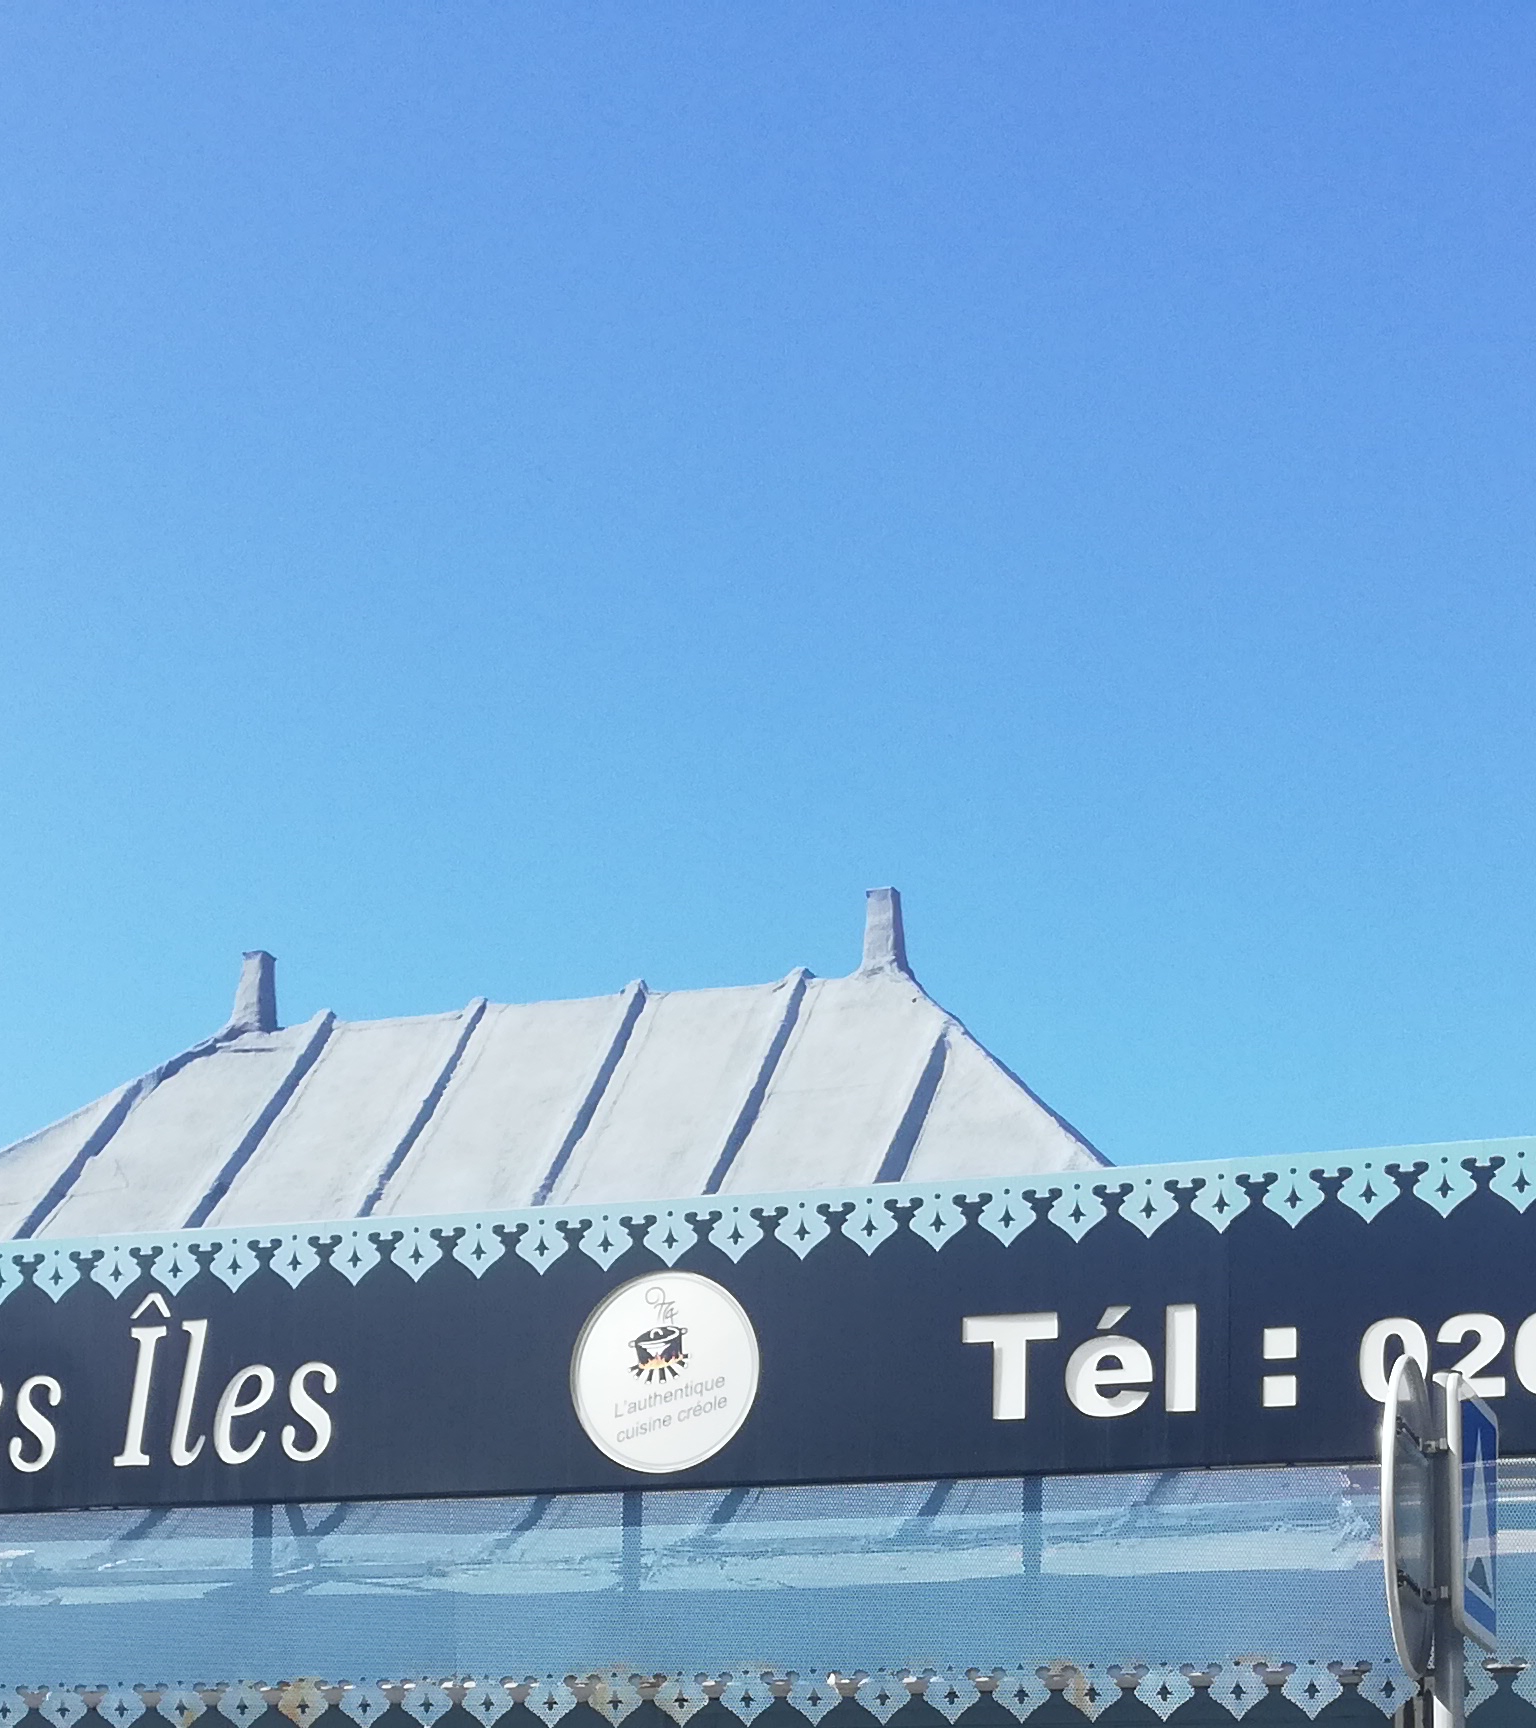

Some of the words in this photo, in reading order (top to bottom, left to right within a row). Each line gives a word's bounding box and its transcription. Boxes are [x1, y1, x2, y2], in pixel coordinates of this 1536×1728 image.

[113, 1292, 339, 1468] Îles
[613, 1375, 726, 1419] L'authentique
[962, 1303, 1197, 1421] Tél
[1263, 1327, 1298, 1408] :
[616, 1414, 673, 1443] cuisine
[676, 1395, 728, 1423] créole
